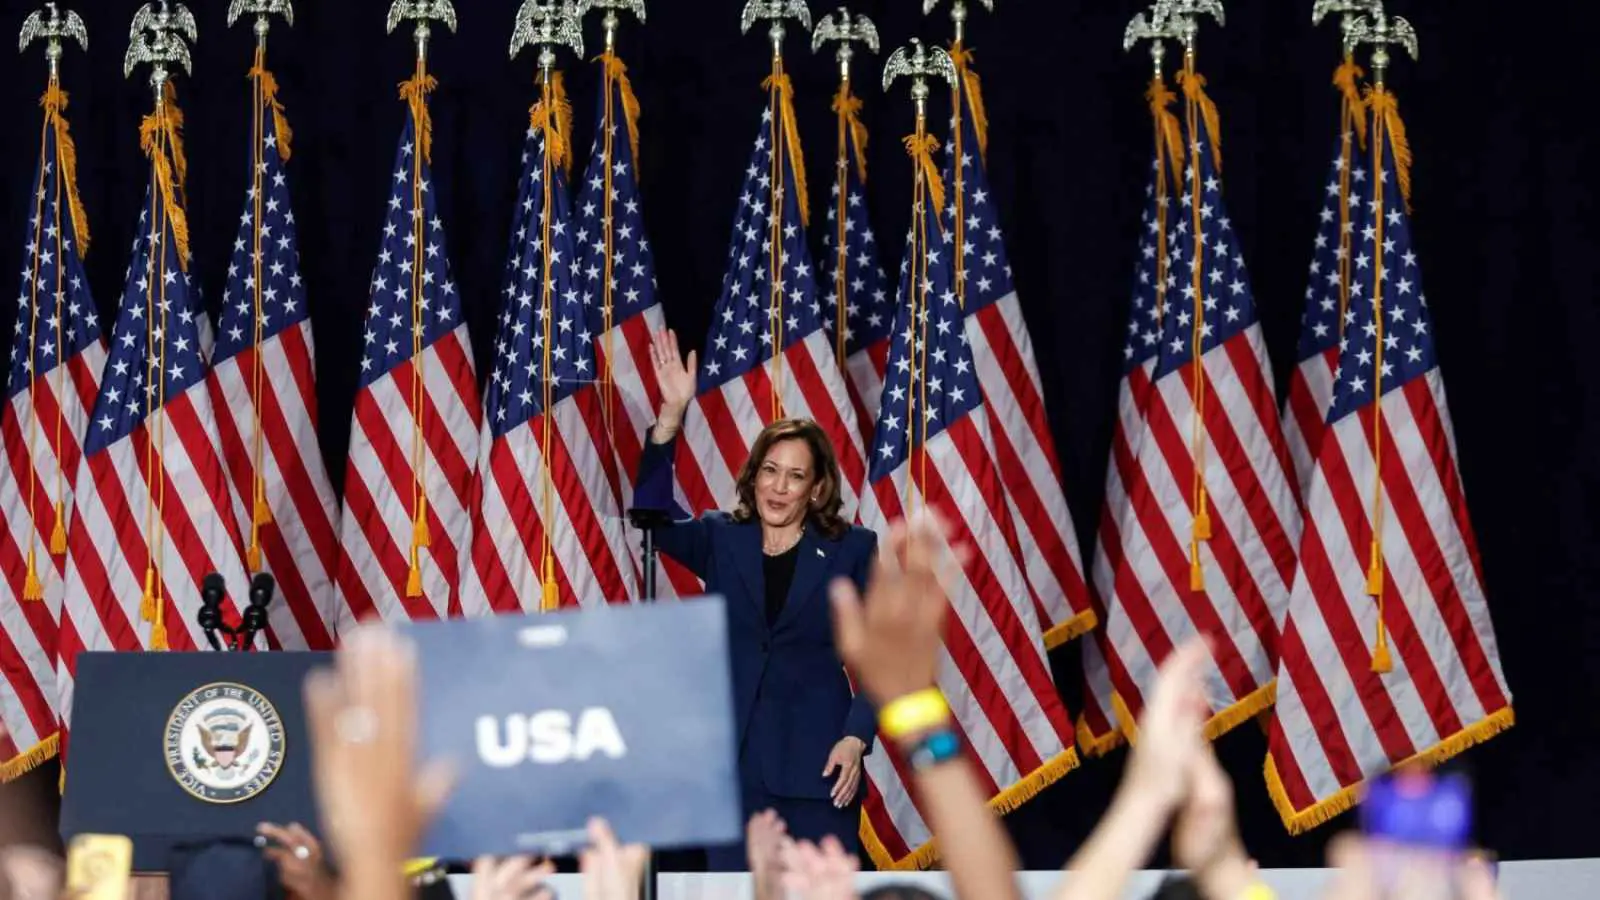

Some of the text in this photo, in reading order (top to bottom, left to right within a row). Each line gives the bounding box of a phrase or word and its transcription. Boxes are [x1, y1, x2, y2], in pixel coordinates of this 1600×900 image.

[168, 687, 281, 796] VICE PRESIDENT OF THE UNITED STATES
[475, 706, 627, 768] USA
